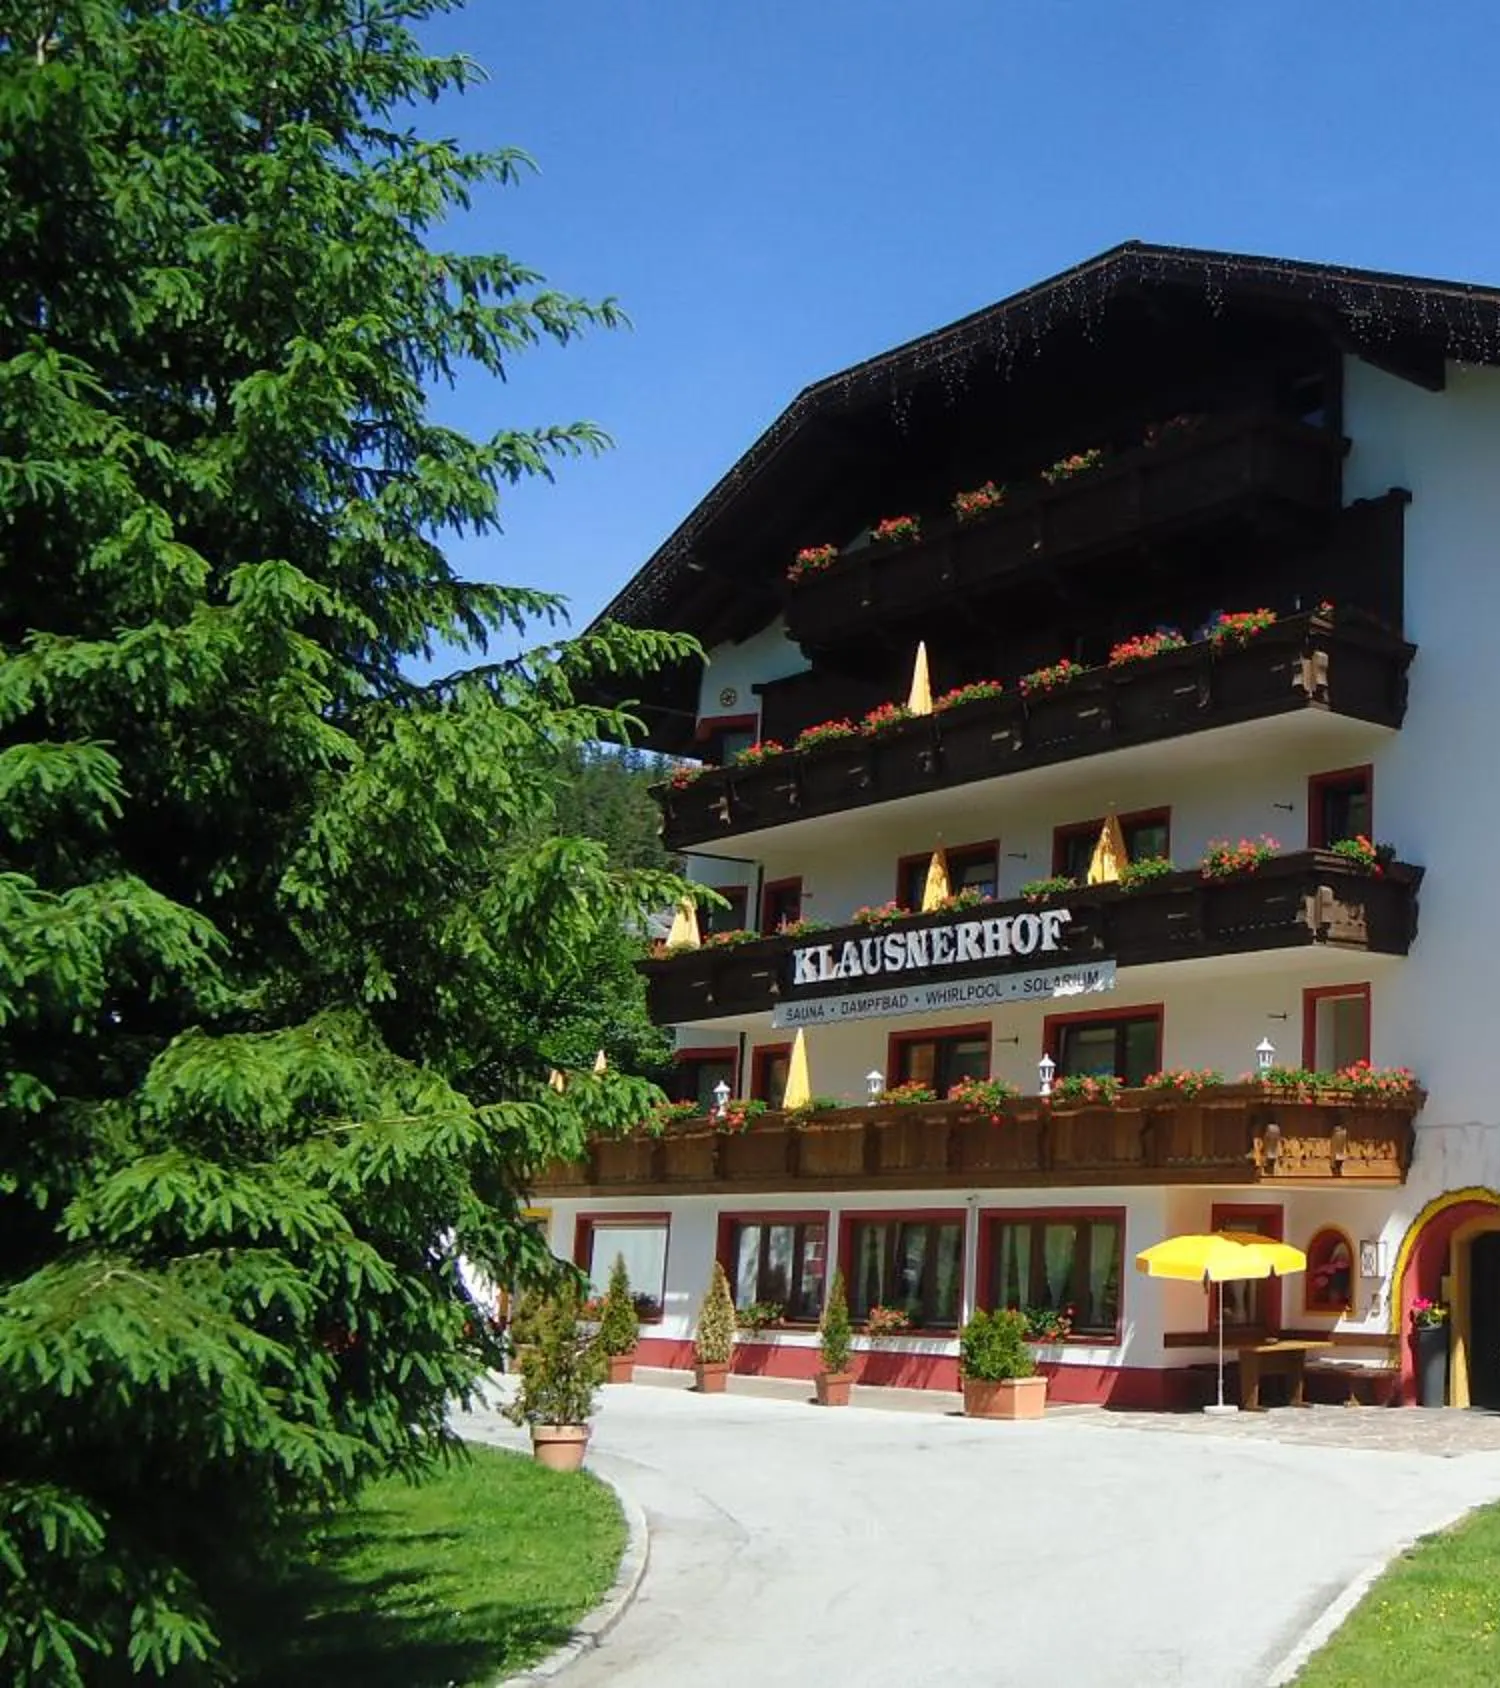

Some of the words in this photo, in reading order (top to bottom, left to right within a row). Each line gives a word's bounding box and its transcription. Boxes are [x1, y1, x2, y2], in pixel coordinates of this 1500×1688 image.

[793, 909, 1072, 985] KLAUSNERHOF
[785, 1003, 825, 1021] SAUNA
[841, 994, 909, 1015] DAMPFBAD
[925, 983, 1003, 1005] WHIRLPOOL
[1023, 970, 1099, 993] SOLARIUM
